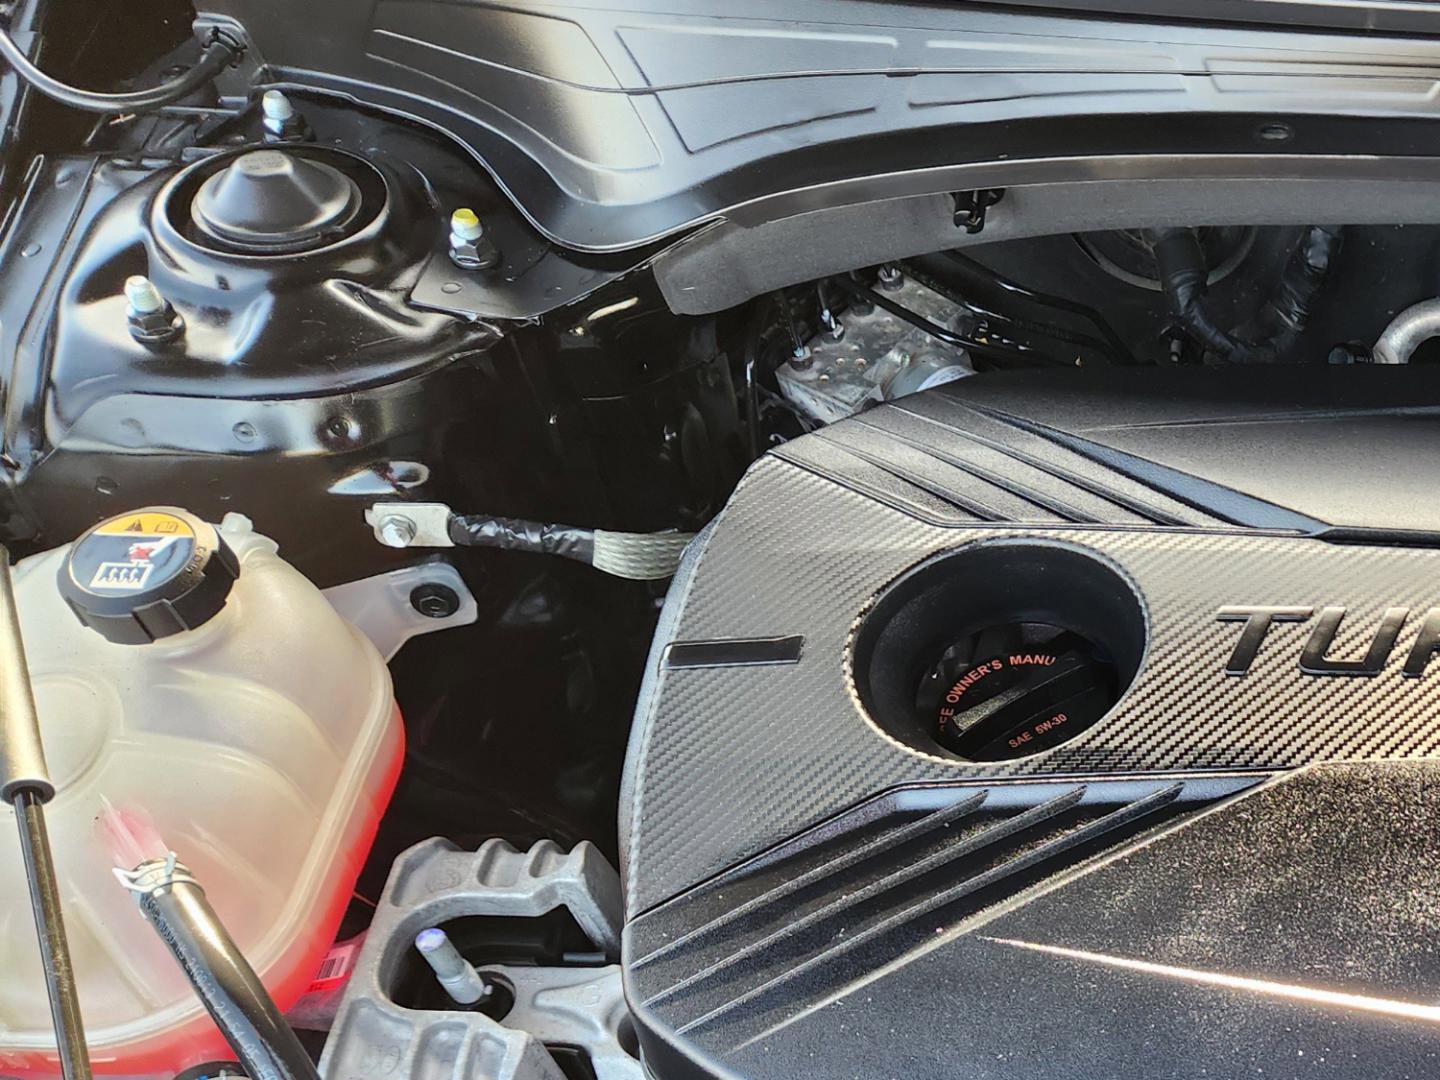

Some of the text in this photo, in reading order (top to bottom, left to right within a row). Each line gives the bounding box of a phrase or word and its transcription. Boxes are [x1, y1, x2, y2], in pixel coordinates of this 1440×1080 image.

[946, 659, 1003, 703] OWNER'S
[1008, 713, 1068, 748] SAE 5W-30
